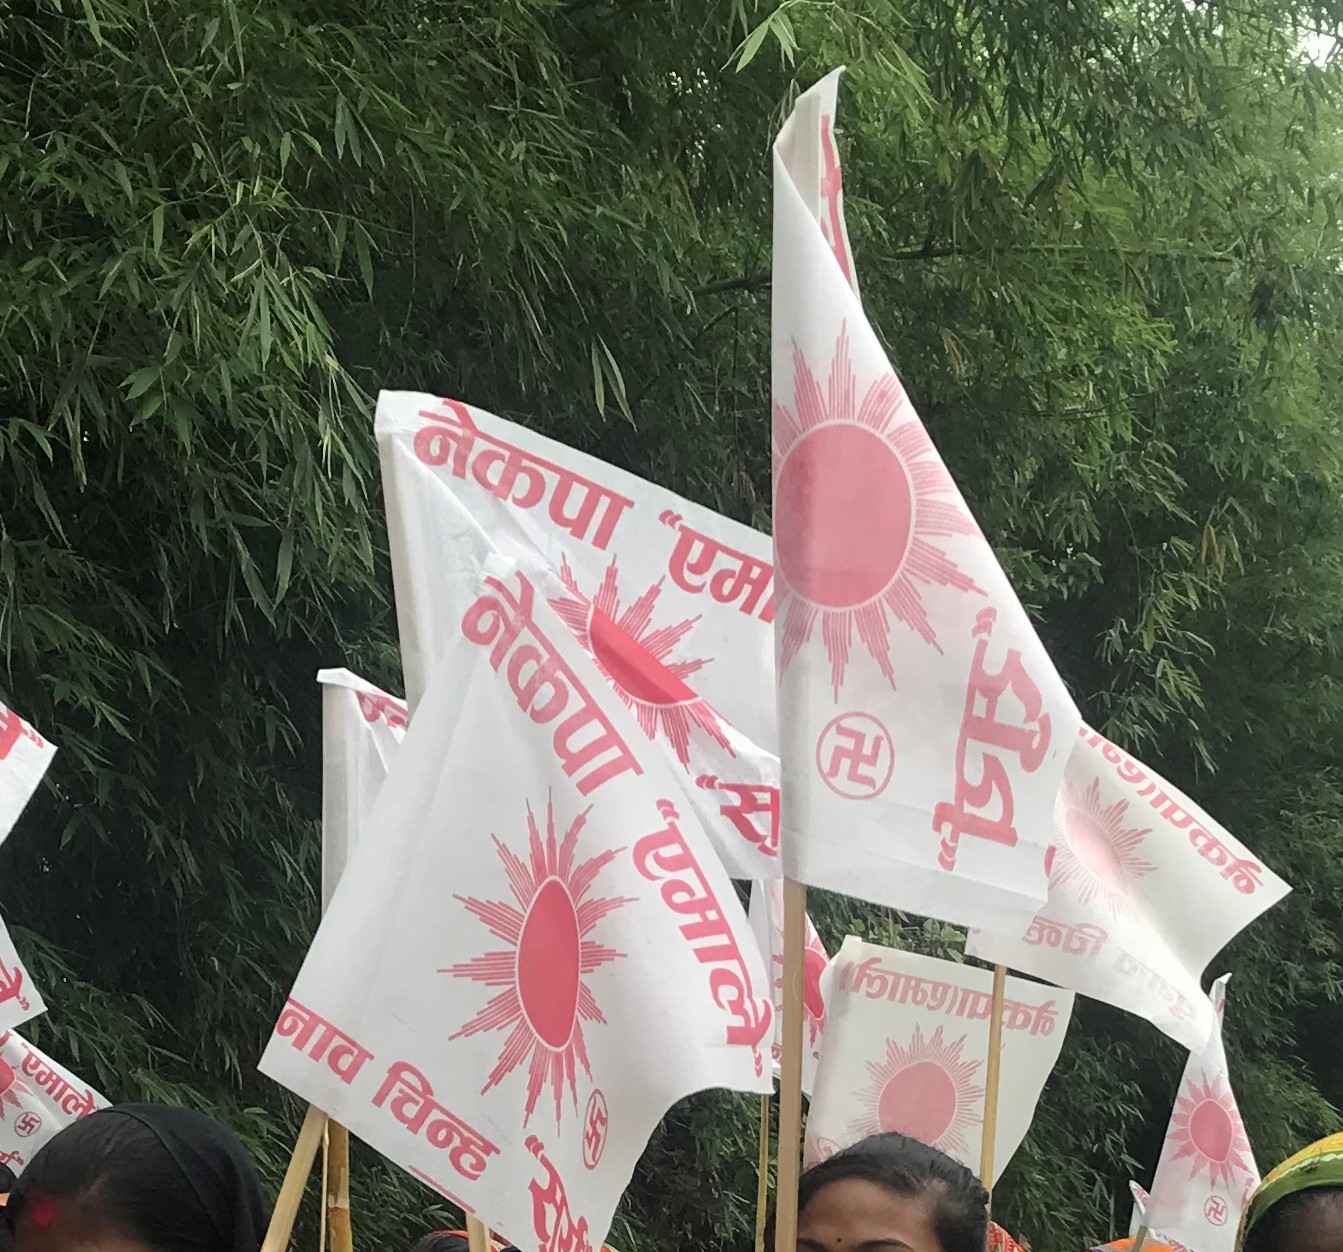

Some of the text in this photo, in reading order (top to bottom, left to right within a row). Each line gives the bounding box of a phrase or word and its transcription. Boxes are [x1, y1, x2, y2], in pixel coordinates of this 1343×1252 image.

[412, 398, 635, 551] नेकपा
[461, 569, 644, 798] नेकपा
[371, 1060, 501, 1181] चिन्ह
